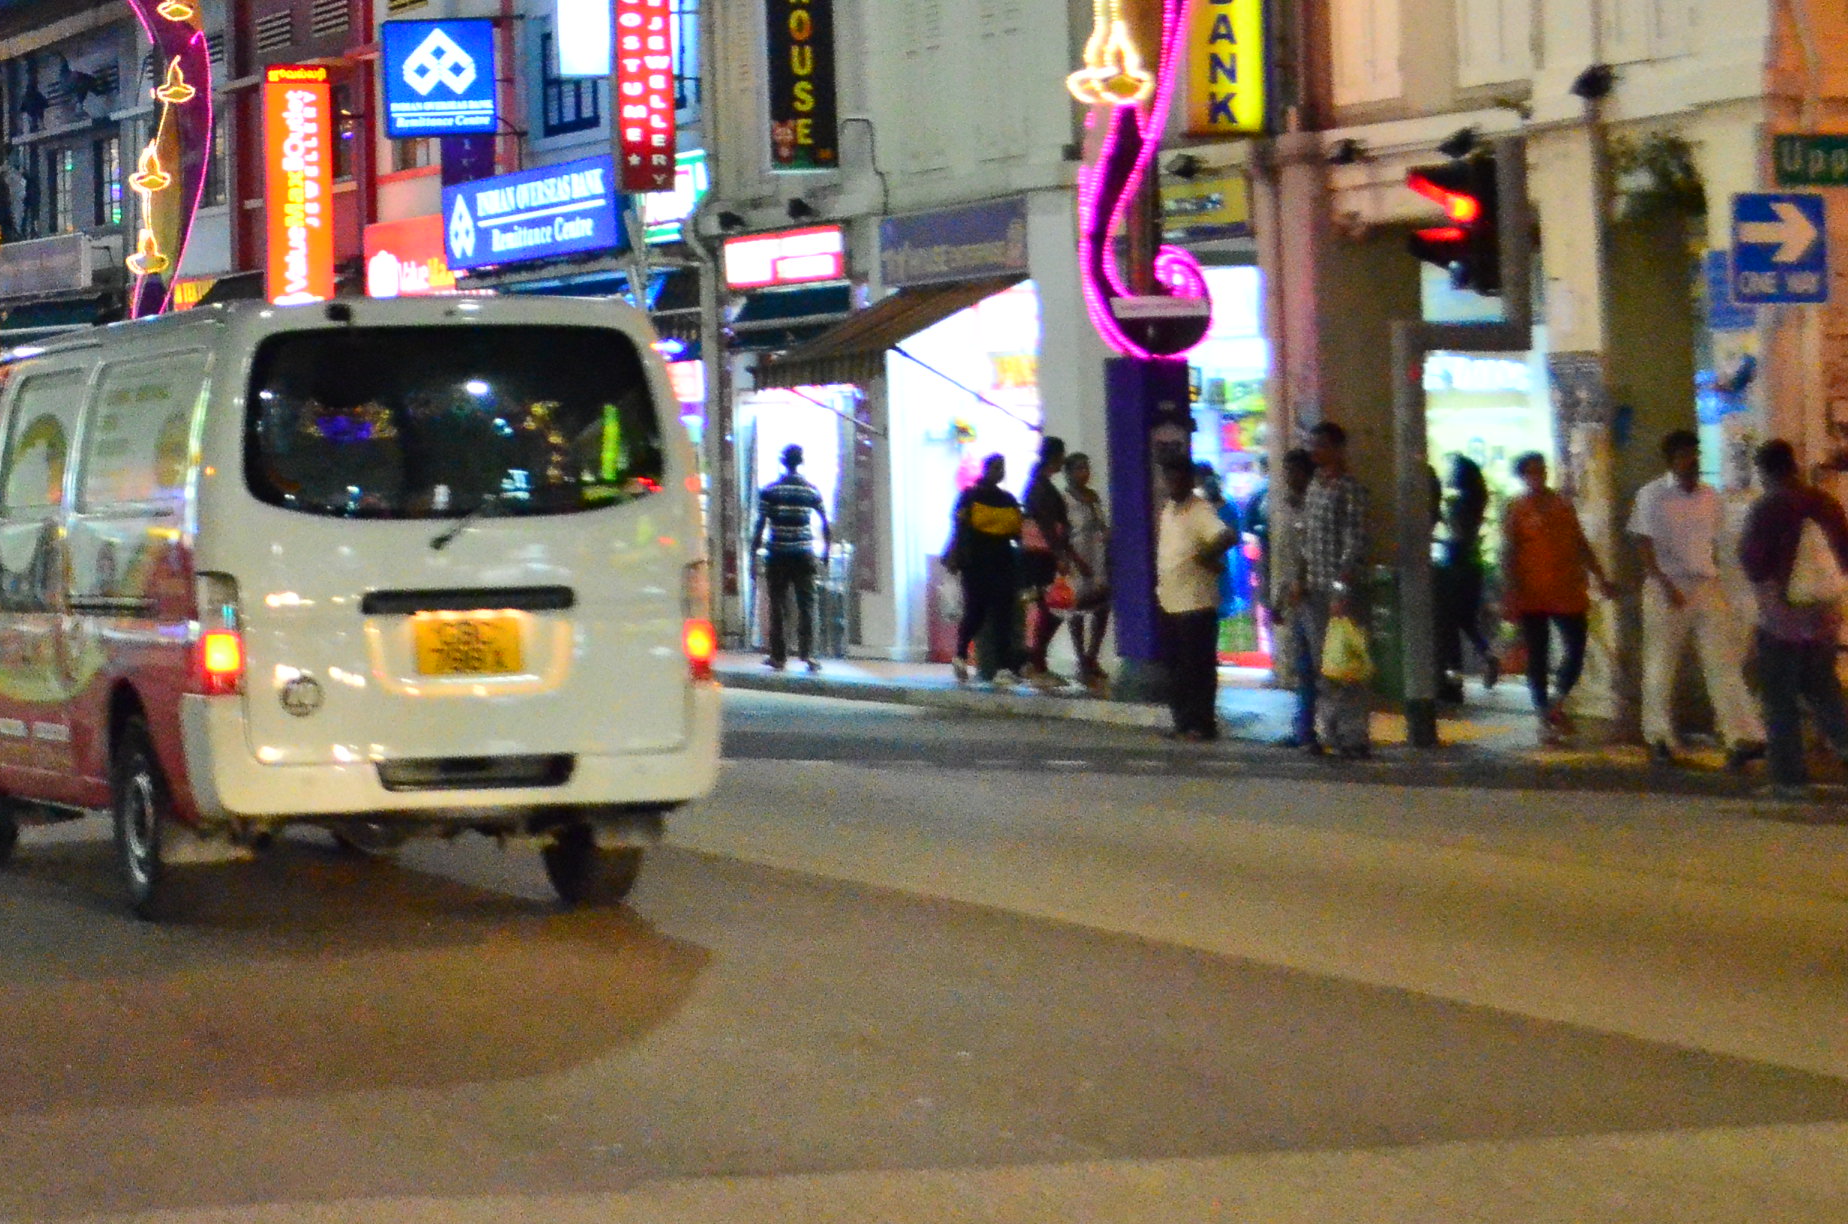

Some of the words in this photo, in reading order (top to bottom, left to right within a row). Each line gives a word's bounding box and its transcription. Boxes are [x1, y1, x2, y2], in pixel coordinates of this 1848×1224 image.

[390, 102, 424, 113] INDIAN
[425, 100, 468, 112] OVERSEAS
[469, 99, 495, 110] BANK
[395, 116, 454, 128] Remittance
[455, 114, 492, 127] Centre
[643, 16, 671, 185] JEWELLERY
[302, 91, 320, 228] JEWELLERY
[476, 186, 515, 217] INDIAN
[516, 174, 571, 210] OVERSEAS
[571, 167, 605, 199] BANK
[491, 223, 553, 252] Remittance
[554, 216, 594, 243] Centre
